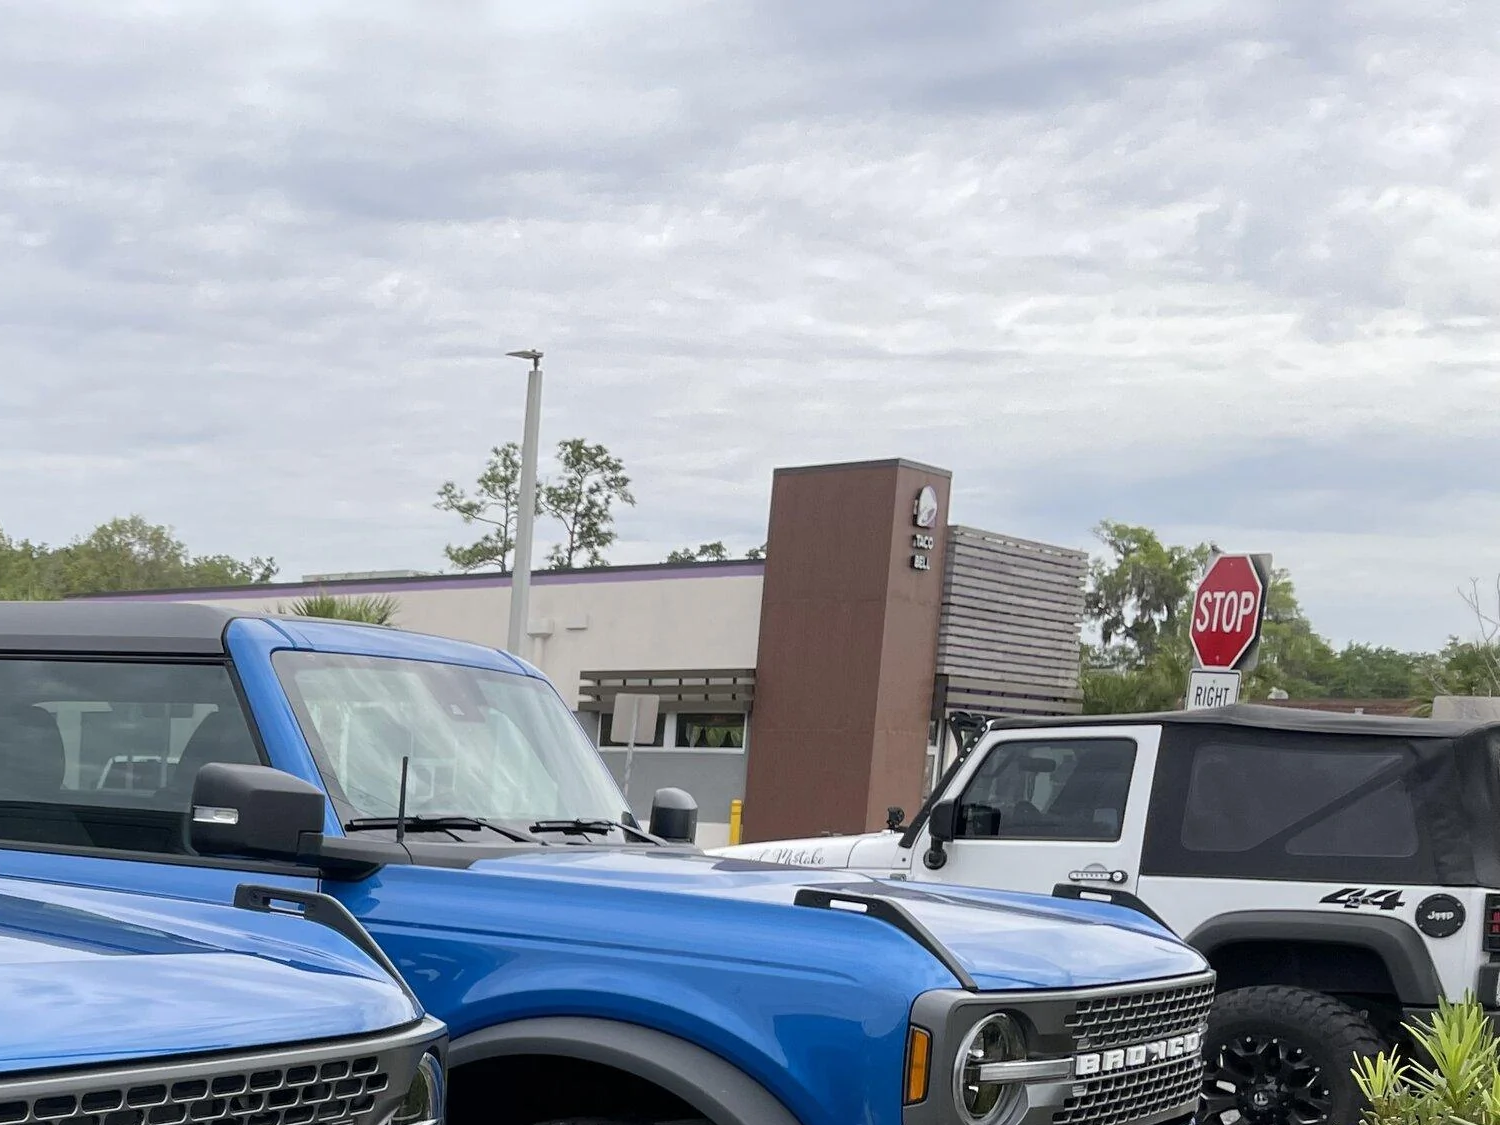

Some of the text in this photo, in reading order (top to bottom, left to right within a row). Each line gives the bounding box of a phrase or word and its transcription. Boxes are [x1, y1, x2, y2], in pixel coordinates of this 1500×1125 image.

[915, 534, 934, 550] TACO
[914, 555, 931, 570] BELL
[1196, 591, 1255, 633] STOP
[1194, 686, 1230, 707] RIGHT
[1075, 1033, 1200, 1075] BRONCO
